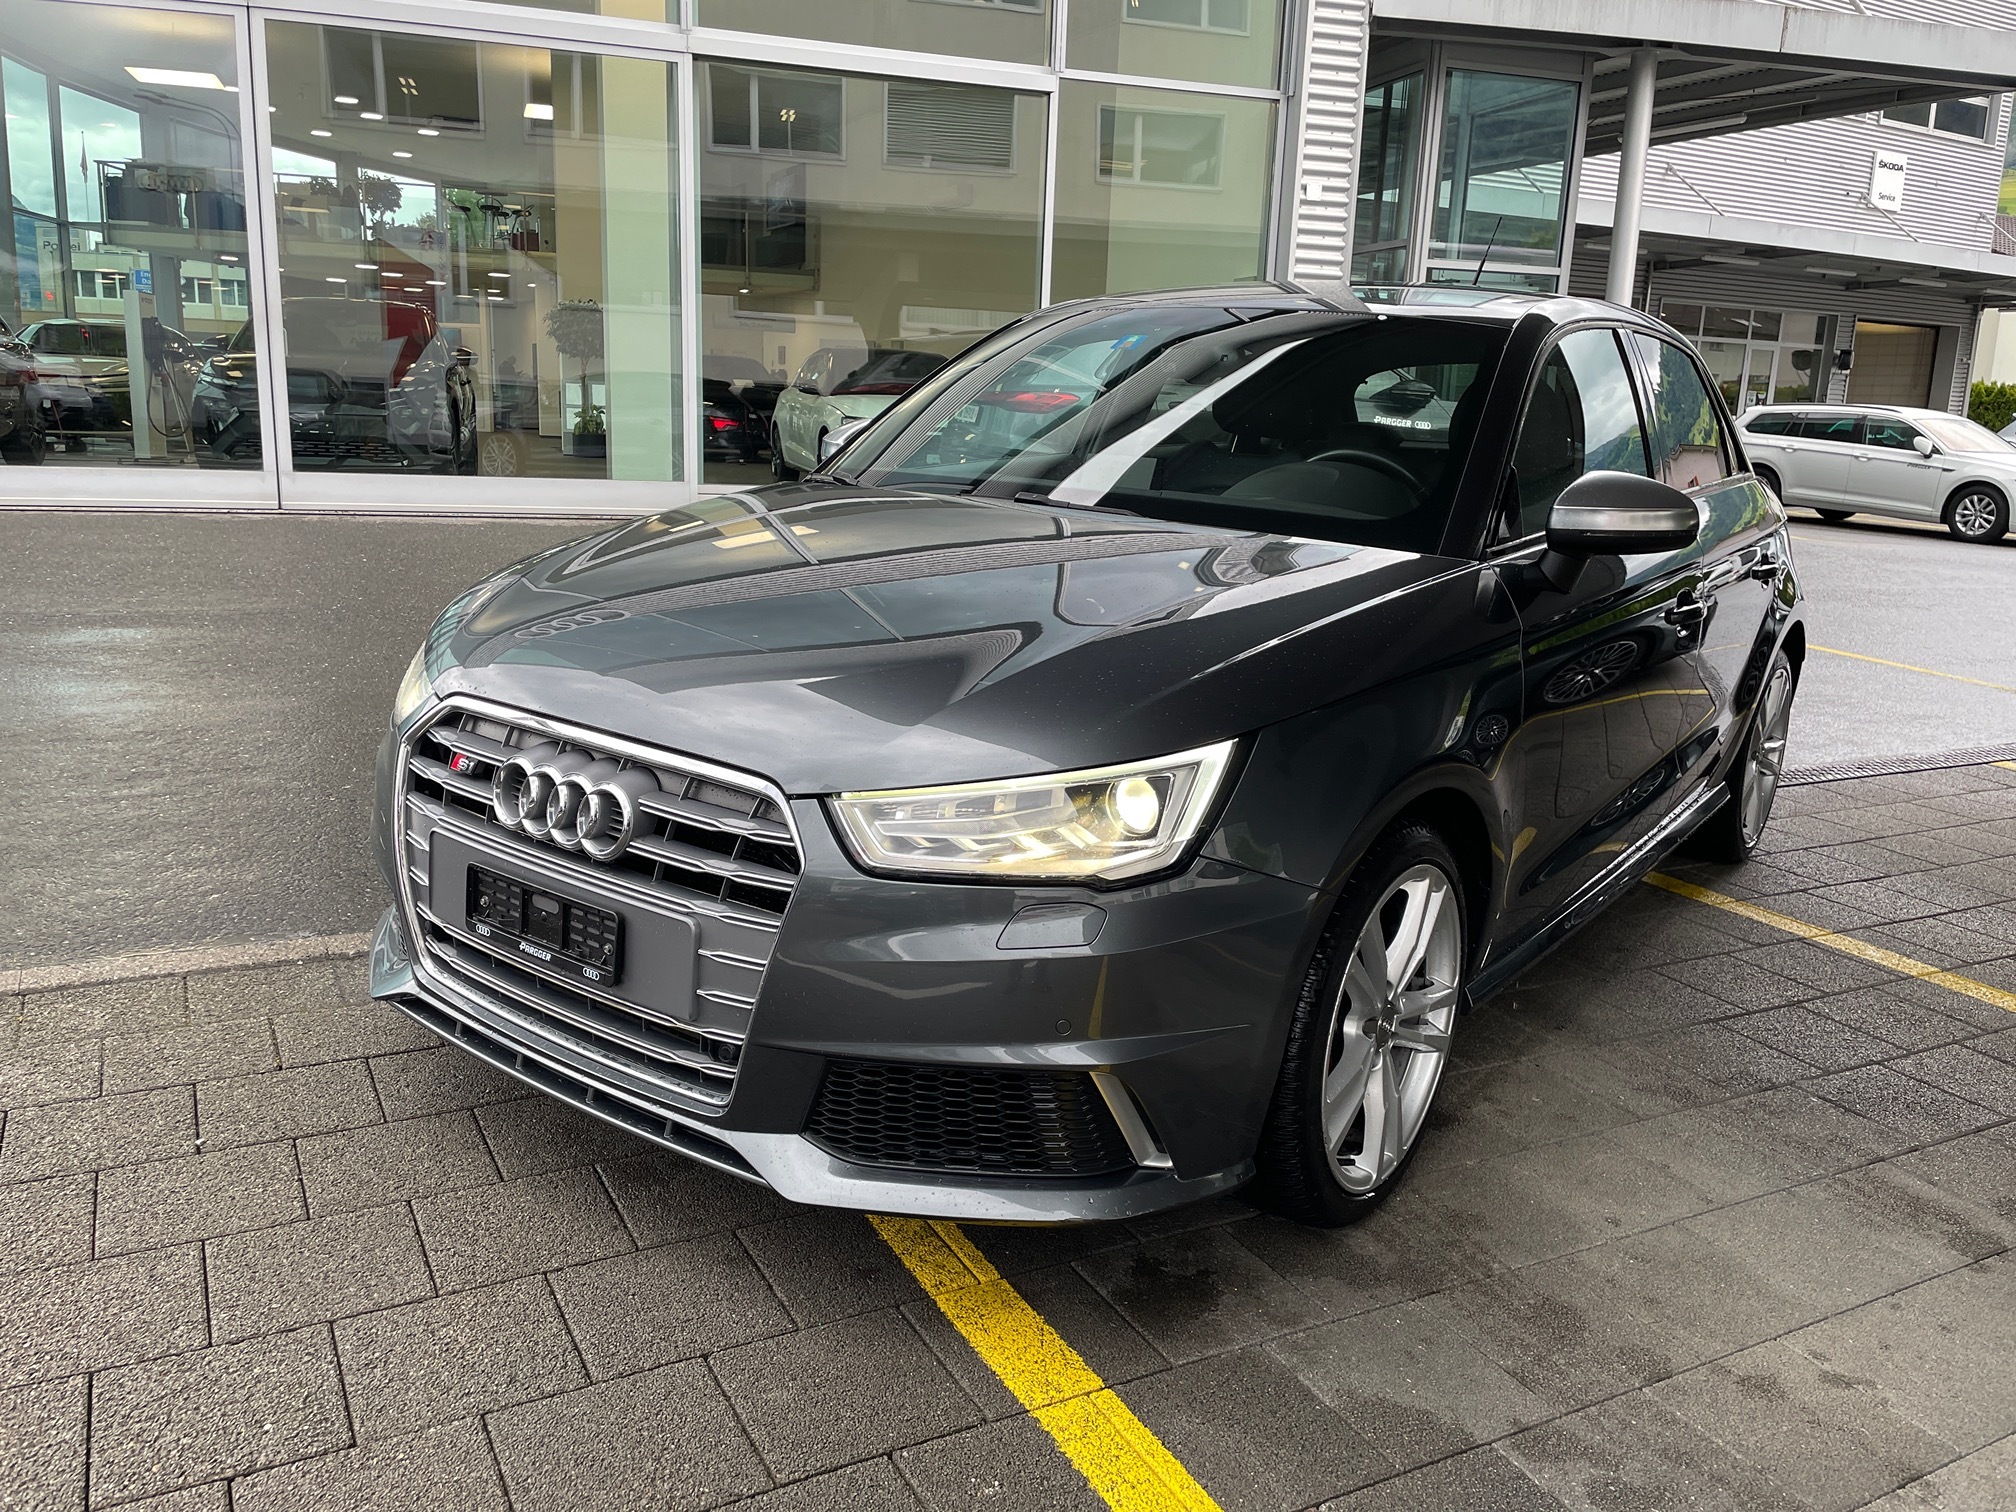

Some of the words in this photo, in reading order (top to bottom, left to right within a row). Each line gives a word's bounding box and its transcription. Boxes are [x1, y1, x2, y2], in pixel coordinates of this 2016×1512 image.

[1878, 160, 1904, 172] ŠKODA
[1878, 192, 1896, 202] Service
[1374, 416, 1411, 428] PARGGER
[457, 757, 475, 775] S1
[519, 942, 552, 962] PARGGER
